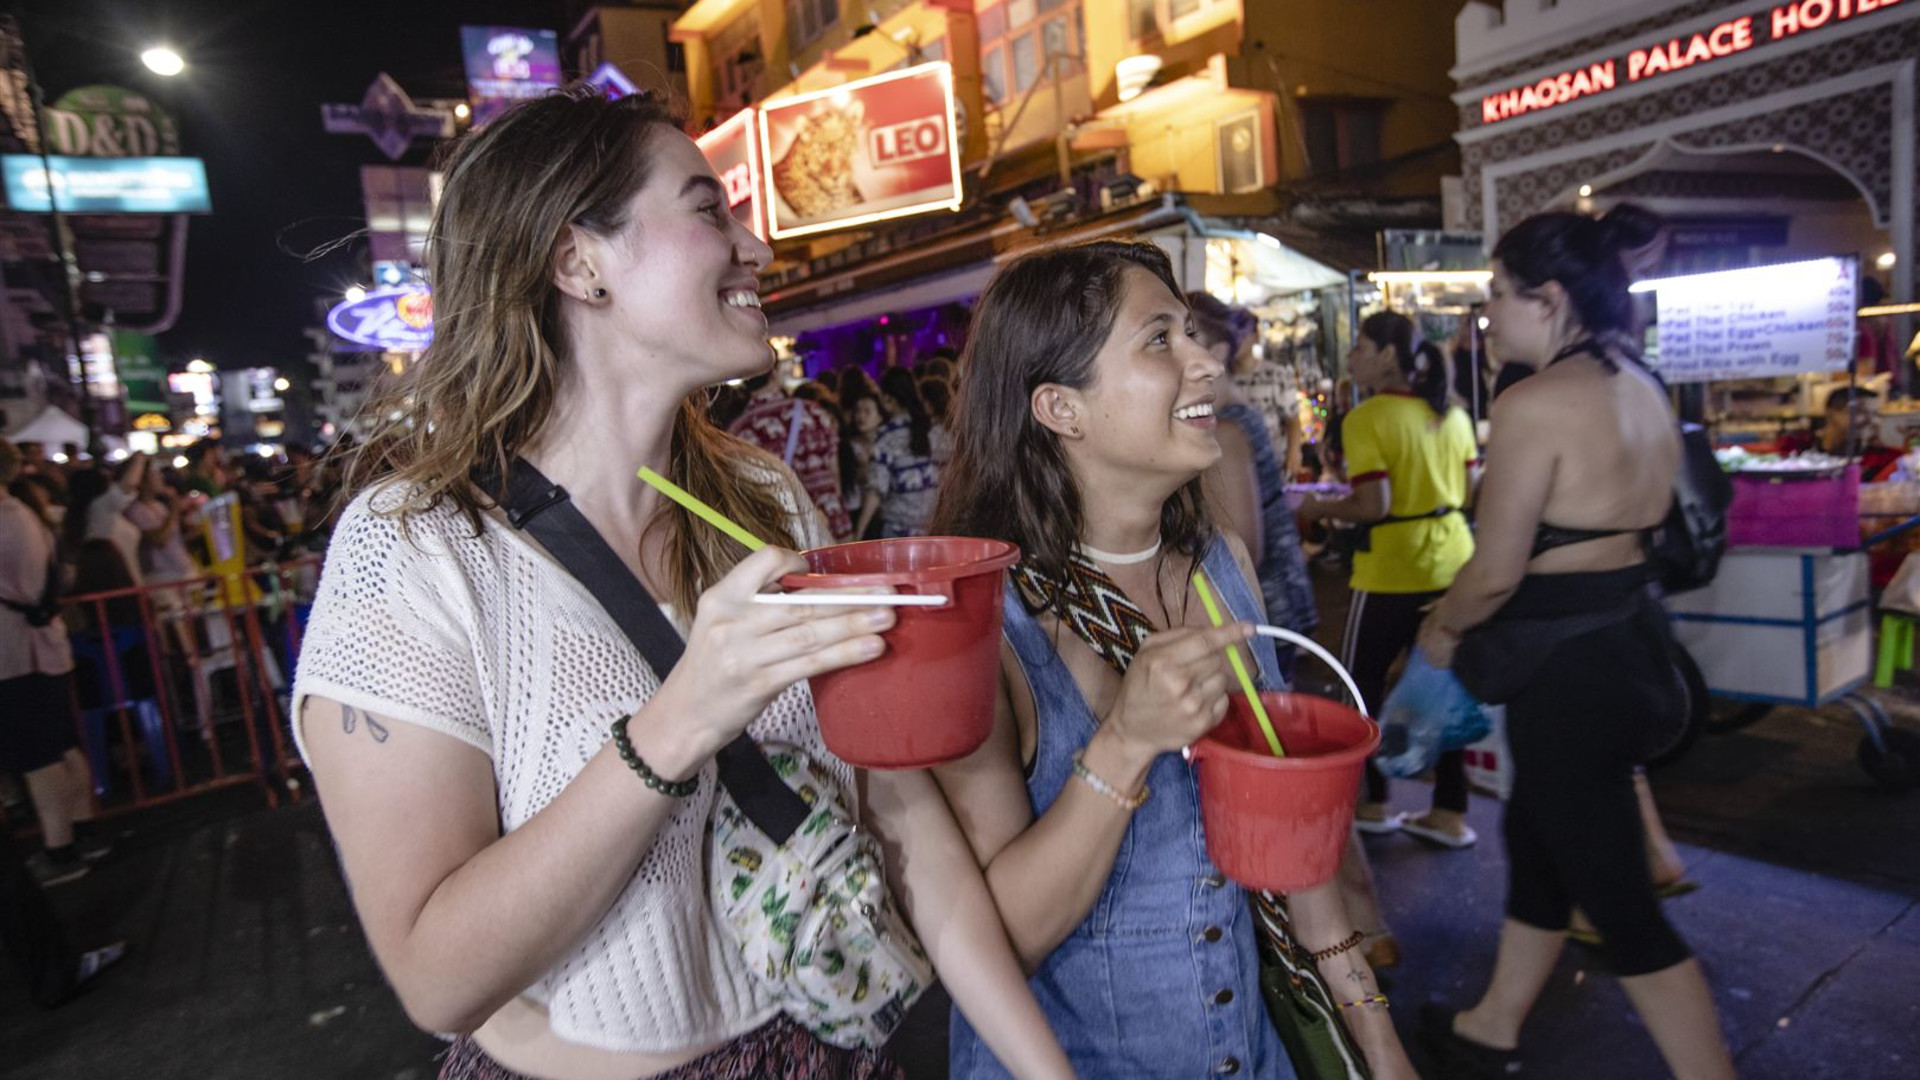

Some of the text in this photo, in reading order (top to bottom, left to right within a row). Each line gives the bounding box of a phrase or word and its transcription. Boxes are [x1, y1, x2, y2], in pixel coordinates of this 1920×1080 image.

[1482, 59, 1615, 123] KHAOSAN
[1626, 16, 1753, 81] PALACE
[44, 107, 159, 156] D&D
[875, 121, 941, 162] LEO
[1696, 315, 1723, 325] Thai
[1728, 310, 1786, 323] Chicken
[1696, 330, 1723, 340] Thai
[1696, 344, 1723, 354] Thai
